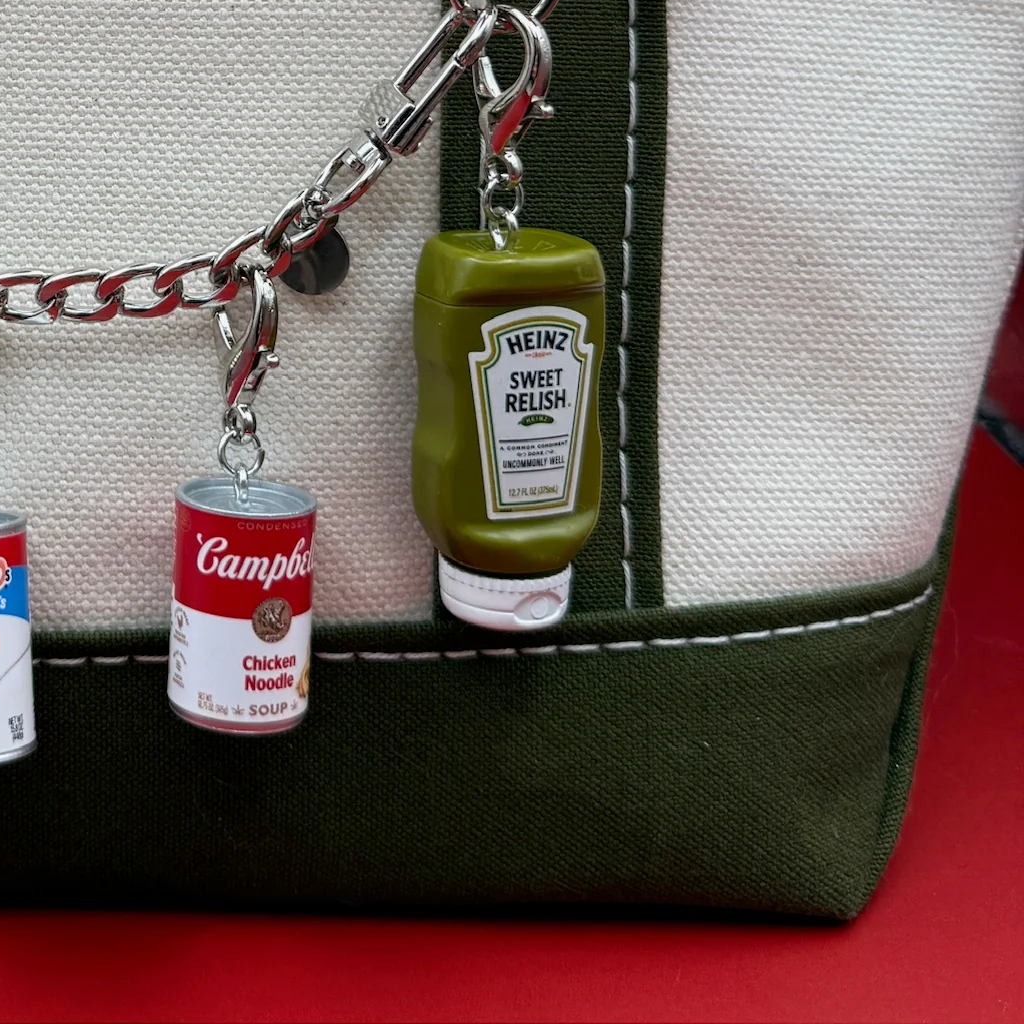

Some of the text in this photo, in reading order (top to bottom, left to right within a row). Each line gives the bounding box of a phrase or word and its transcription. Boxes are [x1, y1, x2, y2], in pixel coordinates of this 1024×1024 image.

[506, 330, 569, 355] HEINZ
[509, 368, 563, 389] SWEET
[505, 389, 566, 413] RELISH
[502, 455, 564, 469] UNCOMMONLY WELL
[237, 520, 308, 531] CONDENSED
[242, 654, 297, 671] Chicken
[244, 673, 294, 692] Noodle
[249, 702, 288, 716] SOUP
